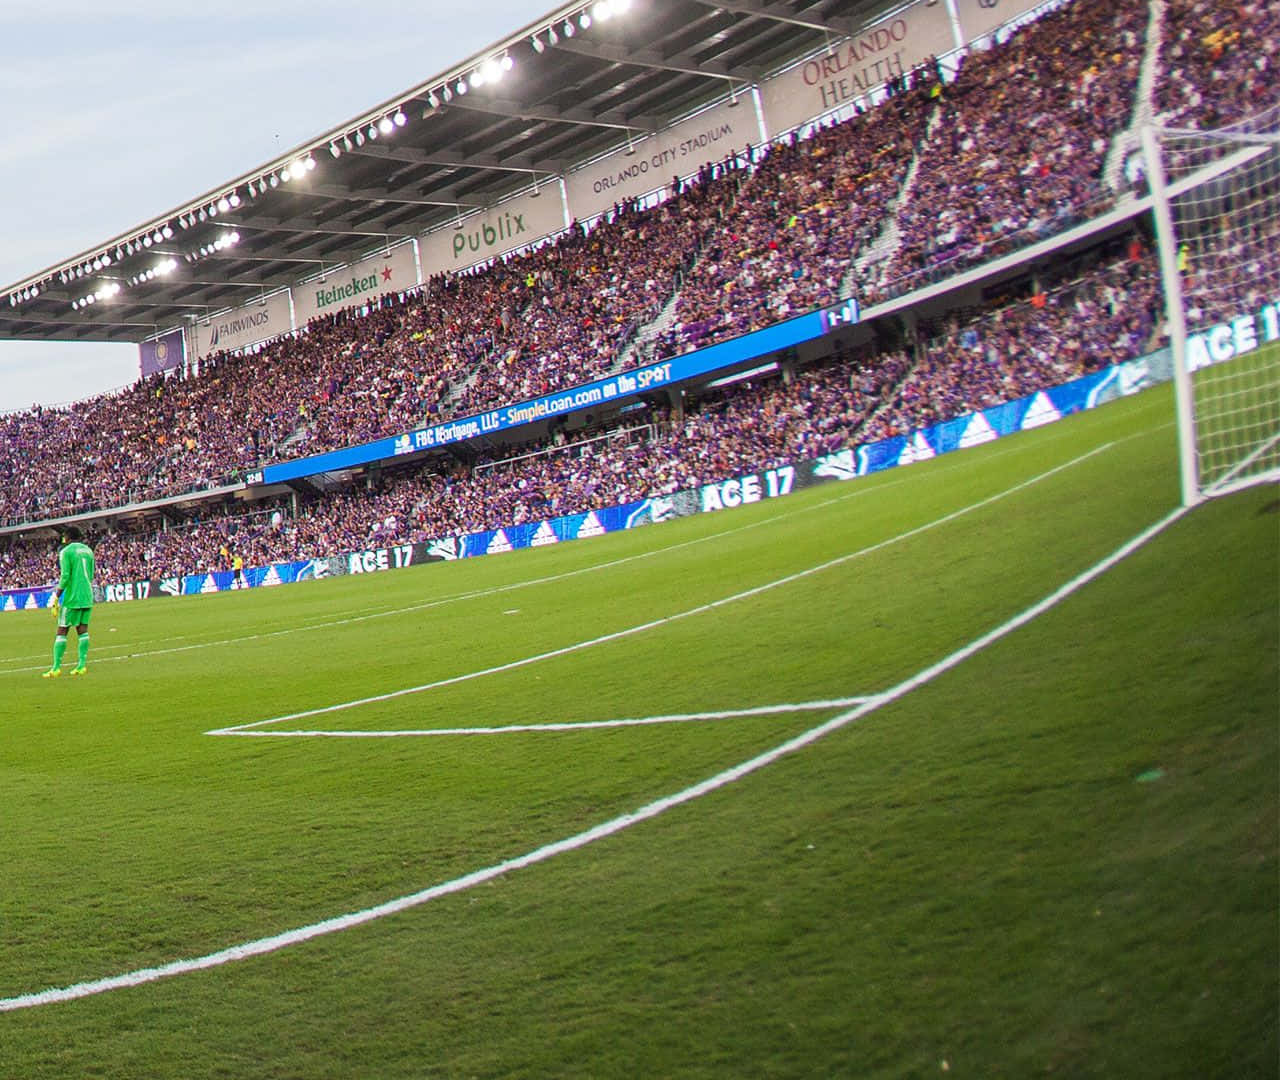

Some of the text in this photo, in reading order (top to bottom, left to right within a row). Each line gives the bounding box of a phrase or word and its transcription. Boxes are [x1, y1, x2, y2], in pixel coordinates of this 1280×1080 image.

[803, 19, 907, 86] ORLANDO
[819, 52, 903, 108] HEALTH
[593, 124, 733, 193] ORLANDO CITY STADIUM
[453, 212, 525, 258] Publix
[315, 273, 378, 308] Heineken
[219, 310, 269, 338] FAIRWINDS
[1184, 303, 1280, 373] ACE 1
[416, 430, 434, 447] FBC
[481, 412, 499, 431] LLC
[507, 387, 601, 423] SimpleLoan.com
[618, 375, 636, 393] the
[637, 363, 672, 388] SPT
[702, 465, 795, 512] ACE 17
[349, 544, 413, 574] ACE 17
[105, 581, 150, 602] ACE 17
